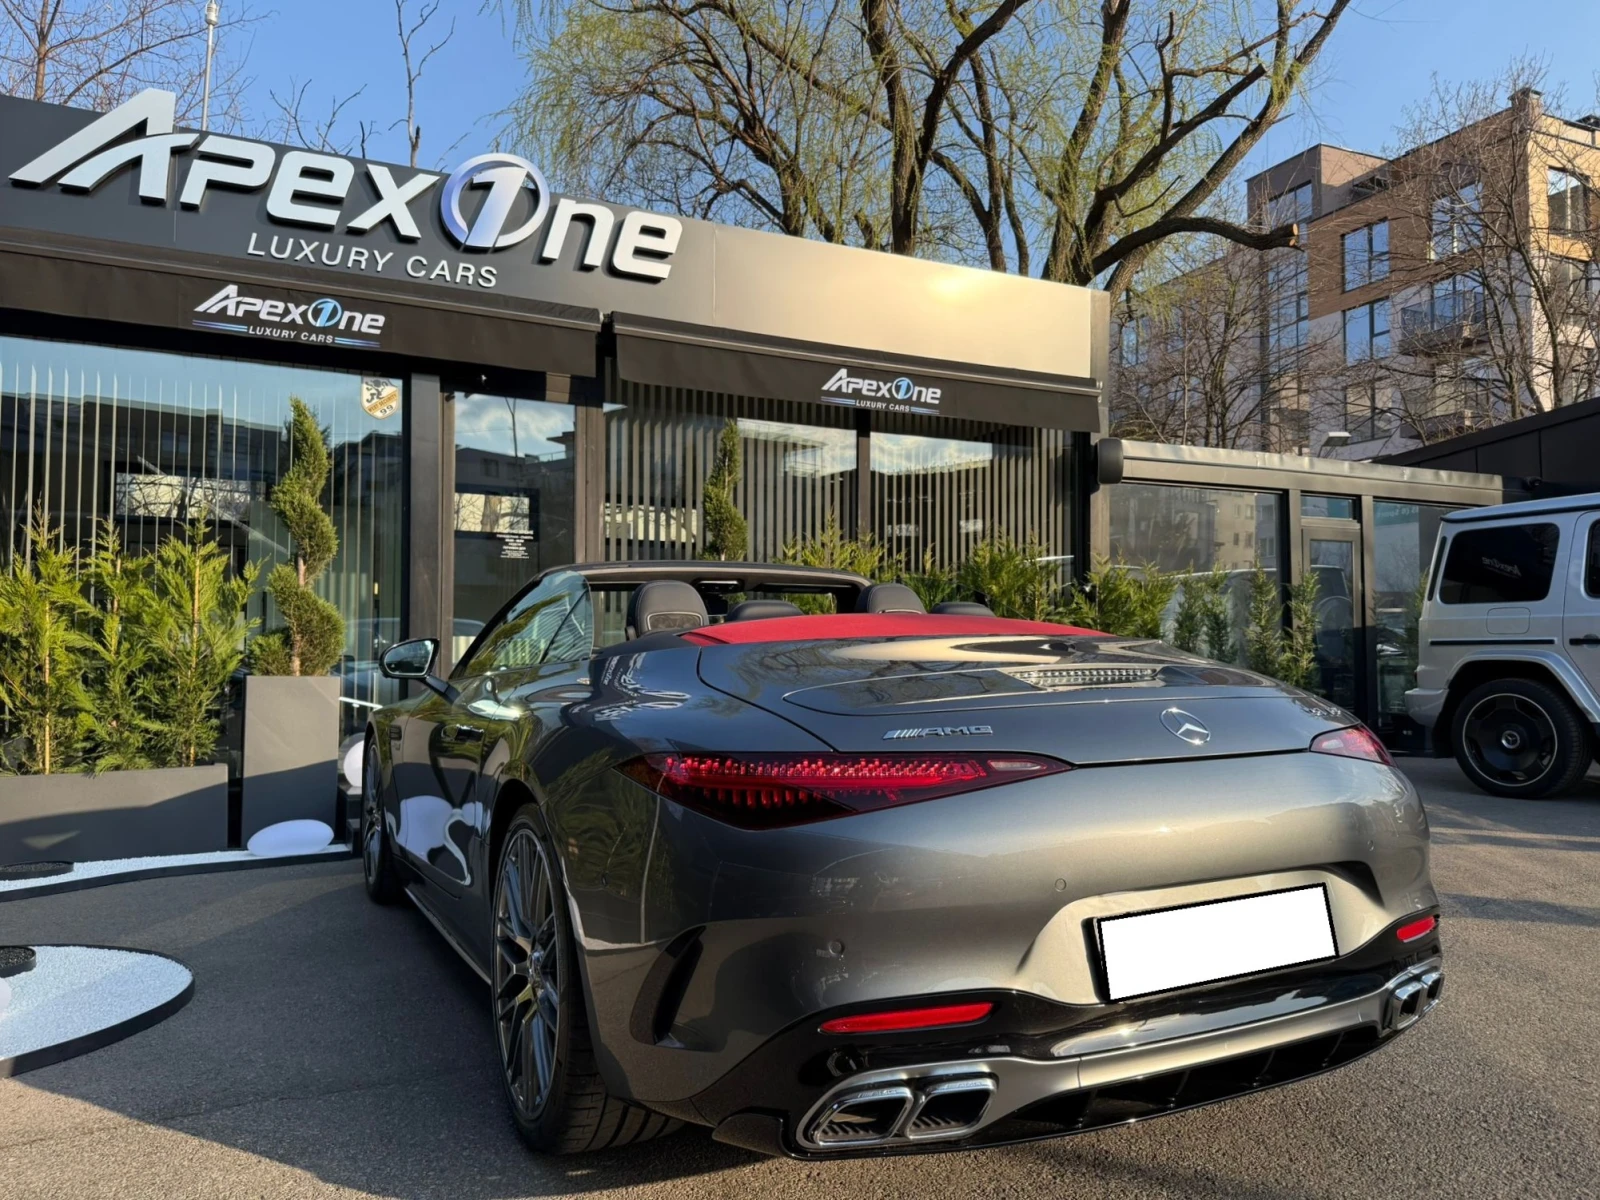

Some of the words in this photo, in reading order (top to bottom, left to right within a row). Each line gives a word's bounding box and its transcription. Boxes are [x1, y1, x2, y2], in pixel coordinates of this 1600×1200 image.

[247, 232, 393, 273] LUXURY
[406, 255, 498, 288] CARS
[248, 325, 297, 340] LUXURY
[301, 332, 334, 344] CARS
[380, 404, 393, 415] 99
[856, 400, 887, 409] LUXURY
[889, 404, 910, 412] CARS
[918, 725, 993, 737] AMG
